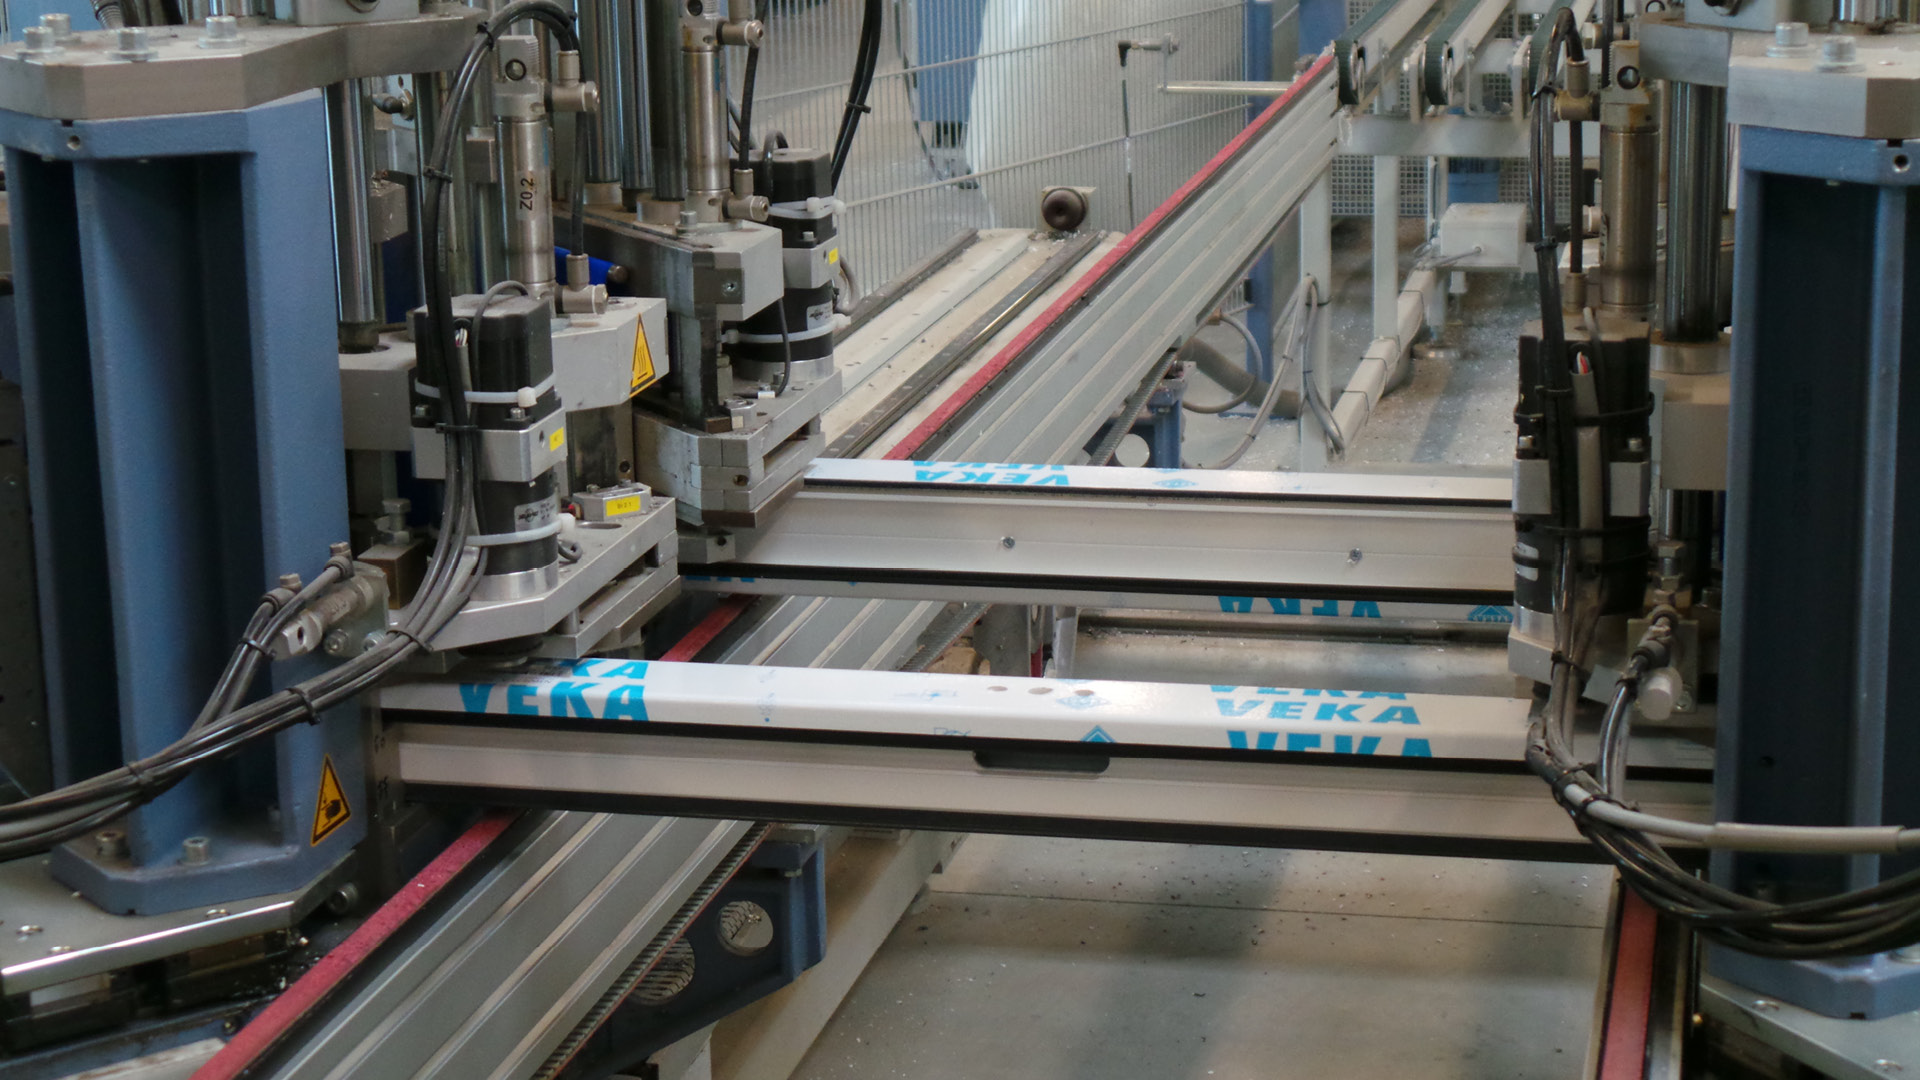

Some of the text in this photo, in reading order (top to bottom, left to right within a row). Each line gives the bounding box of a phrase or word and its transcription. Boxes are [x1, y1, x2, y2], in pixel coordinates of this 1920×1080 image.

[915, 470, 1070, 486] VEKA
[458, 681, 650, 722] VEKA
[1215, 698, 1422, 726] VEKA
